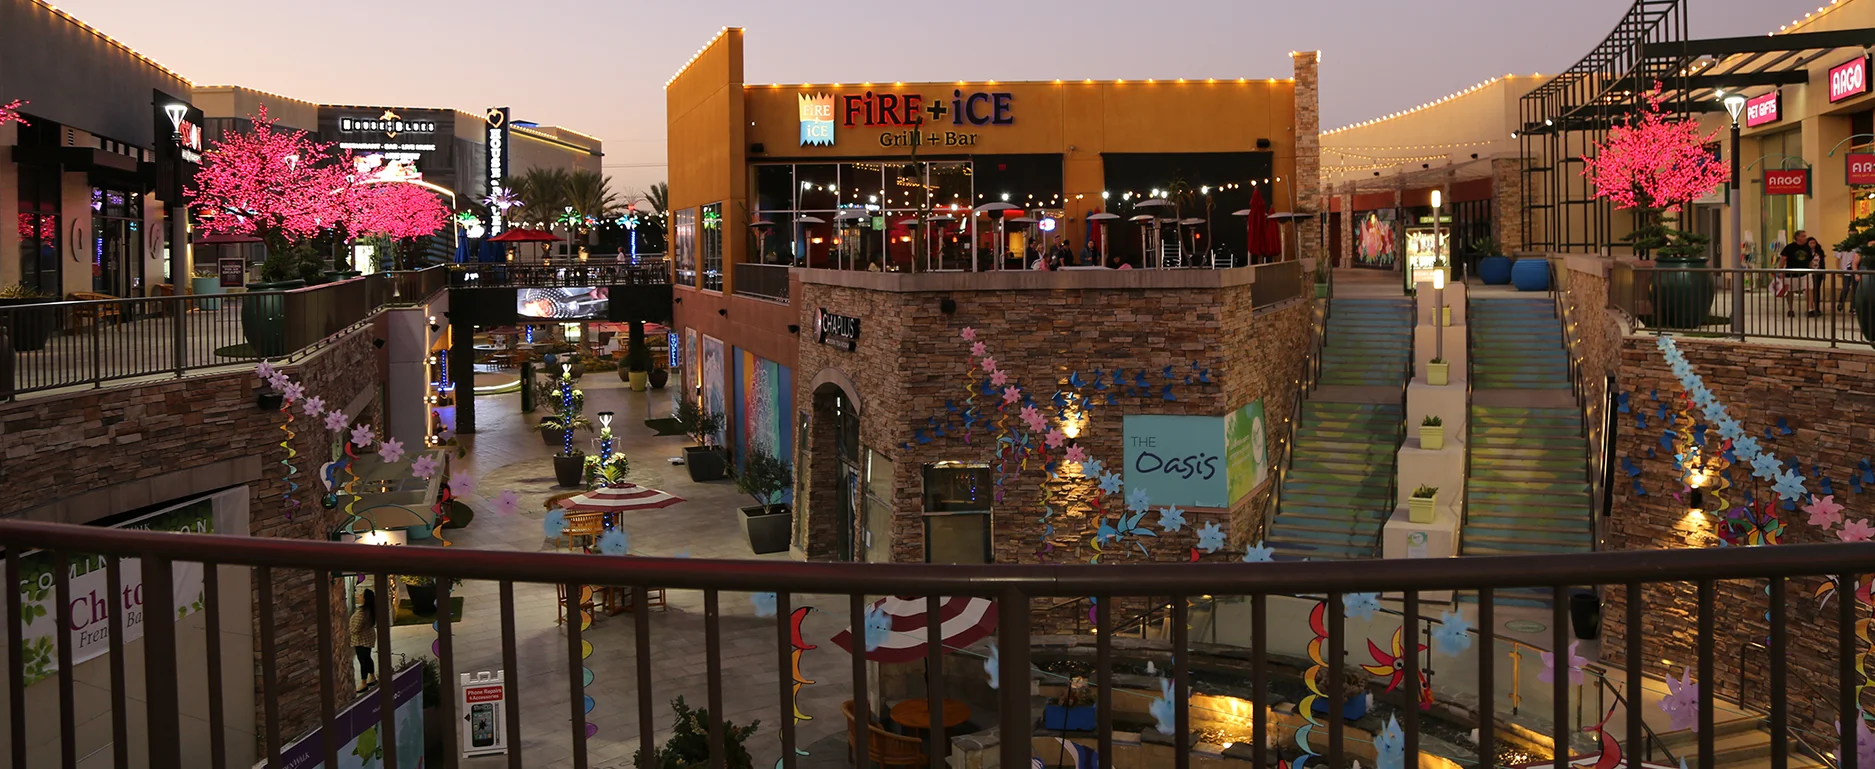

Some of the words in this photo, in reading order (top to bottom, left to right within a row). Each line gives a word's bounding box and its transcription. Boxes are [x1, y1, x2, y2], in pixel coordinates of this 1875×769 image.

[1832, 63, 1863, 97] ARGO
[843, 90, 924, 127] FiRE
[952, 89, 1014, 126] iCE
[1747, 104, 1758, 121] PET
[1759, 99, 1777, 117] GIFTS
[879, 131, 922, 147] Grill
[944, 131, 978, 147] Bar
[1852, 162, 1875, 173] AR
[1768, 176, 1802, 186] ARGO
[1130, 436, 1156, 448] THE
[1135, 450, 1219, 481] Oasis
